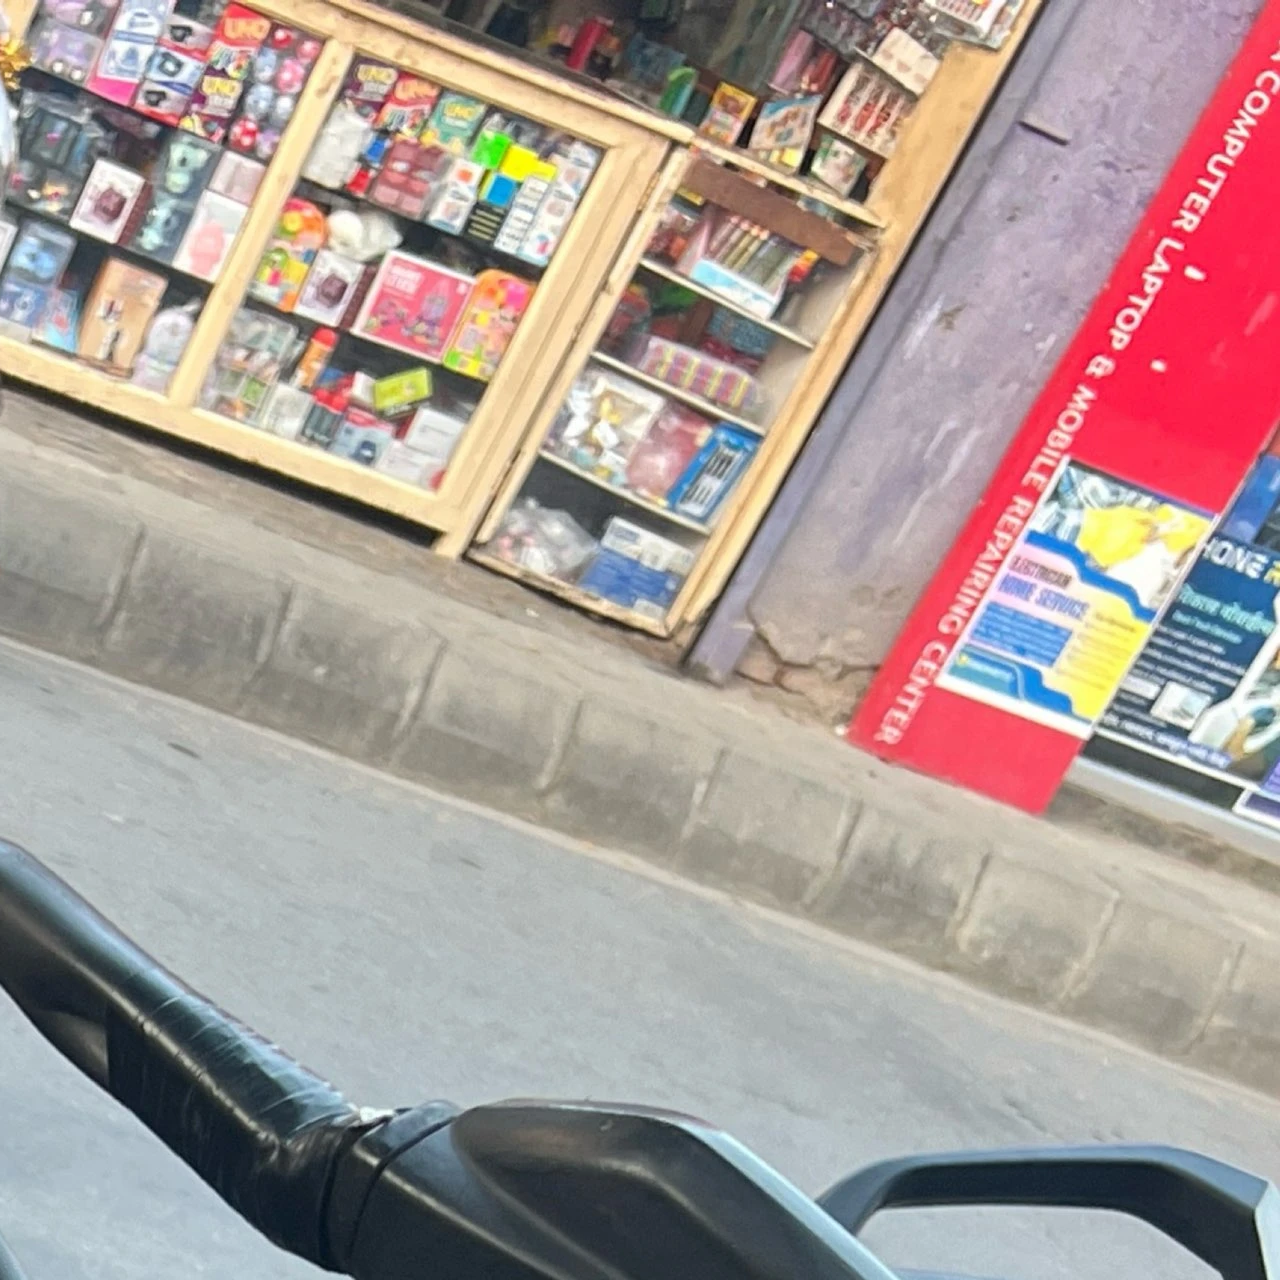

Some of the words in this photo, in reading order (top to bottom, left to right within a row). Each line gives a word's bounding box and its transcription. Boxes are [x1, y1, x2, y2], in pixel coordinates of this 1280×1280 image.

[1171, 70, 1280, 233] COMPUTER
[1108, 237, 1185, 350] LAPTOP
[1085, 354, 1116, 378] &
[1022, 384, 1097, 492] MOBILE
[938, 495, 1035, 635] REPAIRING
[874, 640, 947, 745] CENTER
